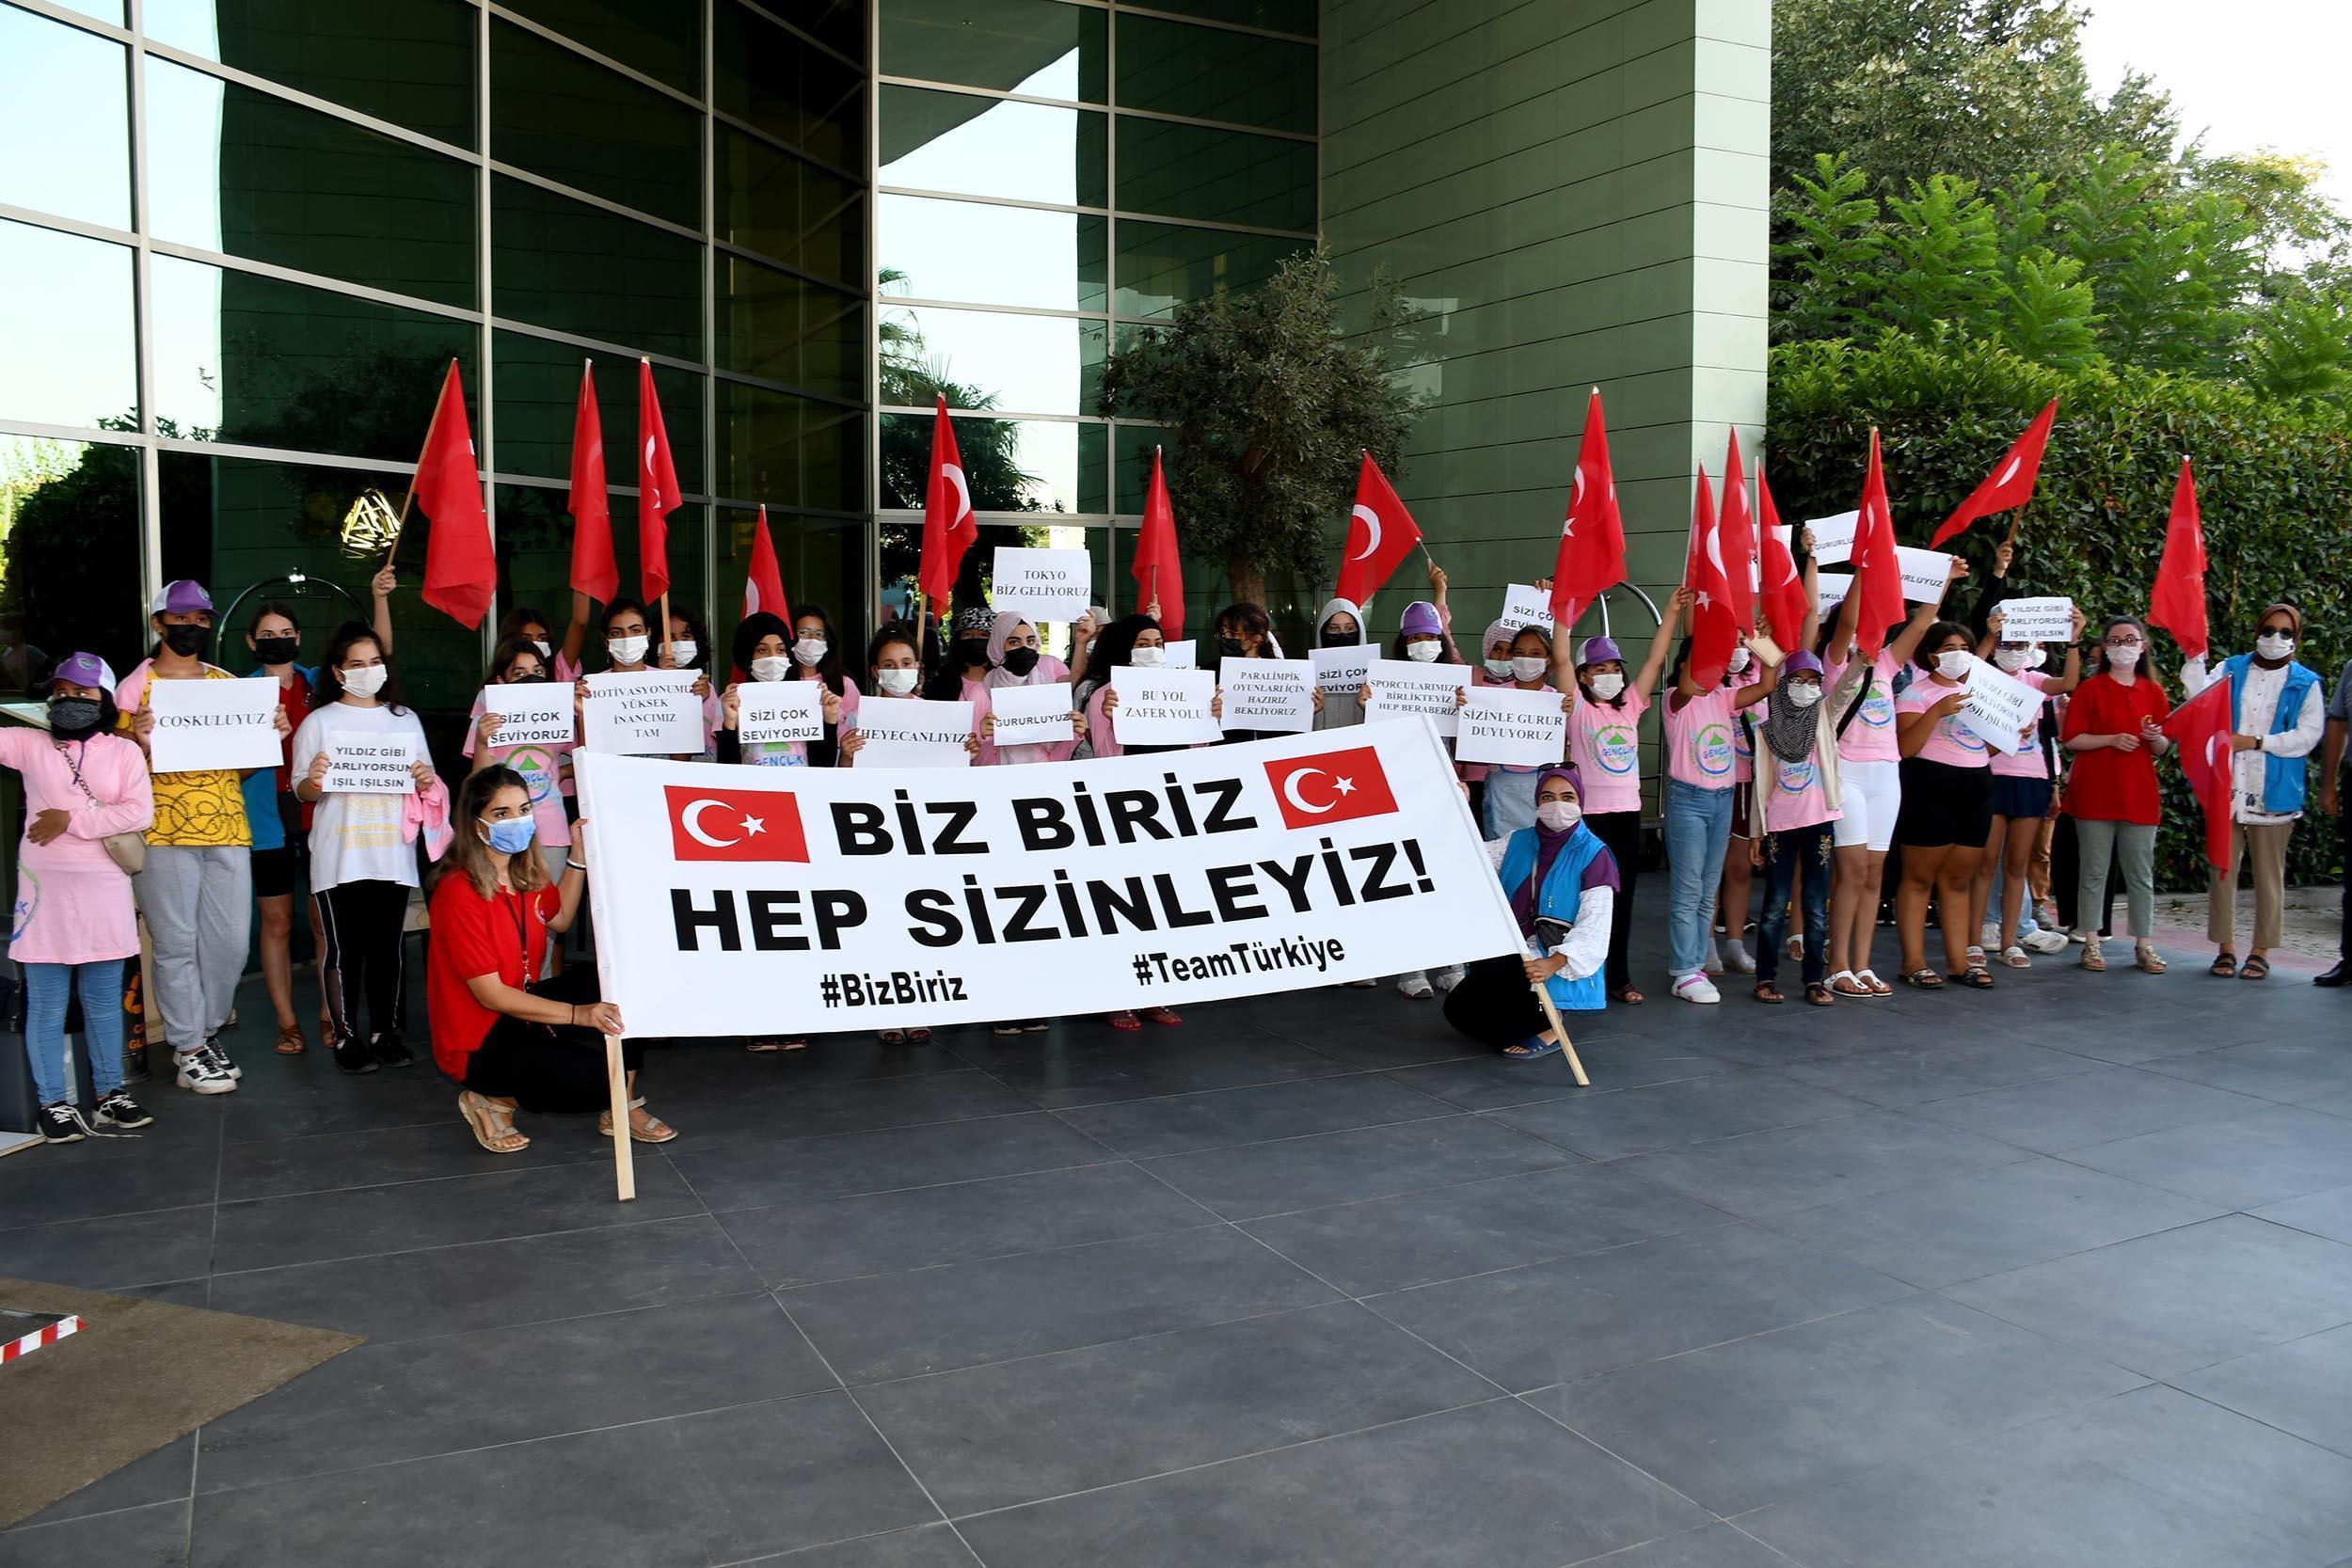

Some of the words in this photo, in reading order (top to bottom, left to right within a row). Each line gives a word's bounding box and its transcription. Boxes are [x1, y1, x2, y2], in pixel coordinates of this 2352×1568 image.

[1024, 570, 1067, 580] TOKYO
[996, 584, 1017, 595] BİZ
[1020, 584, 1089, 597] GELİYORUZ
[1513, 605, 1534, 617] SİZİ
[1538, 611, 1554, 622] ÇO
[1240, 671, 1301, 682] PARALİMPİK
[1319, 669, 1342, 680] SİZİ
[1232, 683, 1283, 692] OYUNLARI
[1285, 684, 1306, 694] İÇİN
[1141, 689, 1159, 702] BU
[1161, 690, 1187, 702] YOL
[1248, 695, 1288, 705] HAZIRIZ
[1386, 691, 1453, 704] BİRLİKTEYİZ
[621, 698, 669, 710] YÜKSEK
[1378, 703, 1399, 711] HEP
[1401, 704, 1458, 716] BERABERİZ
[500, 711, 526, 724] SİZİ
[531, 711, 561, 724] ÇOK
[750, 708, 775, 721] SİZİ
[780, 708, 809, 722] ÇOK
[1125, 707, 1168, 719] ZAFER
[1169, 707, 1204, 720] YOLU
[1233, 706, 1296, 716] BEKLİYORUZ
[1463, 708, 1515, 723] SİZİNLE
[1518, 714, 1563, 726] GURUR
[159, 713, 267, 730] COŞKULUYUZ
[613, 713, 678, 725] İNANCIMIZ
[995, 713, 1070, 728] GURURLUYUZ
[490, 729, 570, 744] SEVİYORUZ
[633, 728, 660, 738] TAM
[741, 726, 820, 741] SEVİYORUZ
[861, 729, 967, 744] HEYECANLIYIZ
[1471, 725, 1553, 741] DUYUYORUZ
[335, 746, 377, 757] YILDIZ
[380, 746, 406, 757] GİBİ
[332, 777, 357, 788] IŞIL
[359, 778, 405, 789] IŞILSIN
[829, 788, 991, 856] BİZ
[1011, 771, 1259, 852] BİRİZ
[670, 888, 868, 952] HEP
[903, 836, 1437, 948] SİZİNLEYİZ!
[1132, 935, 1346, 987] #TeamTürkiye
[819, 969, 969, 1008] #BizBiriz
